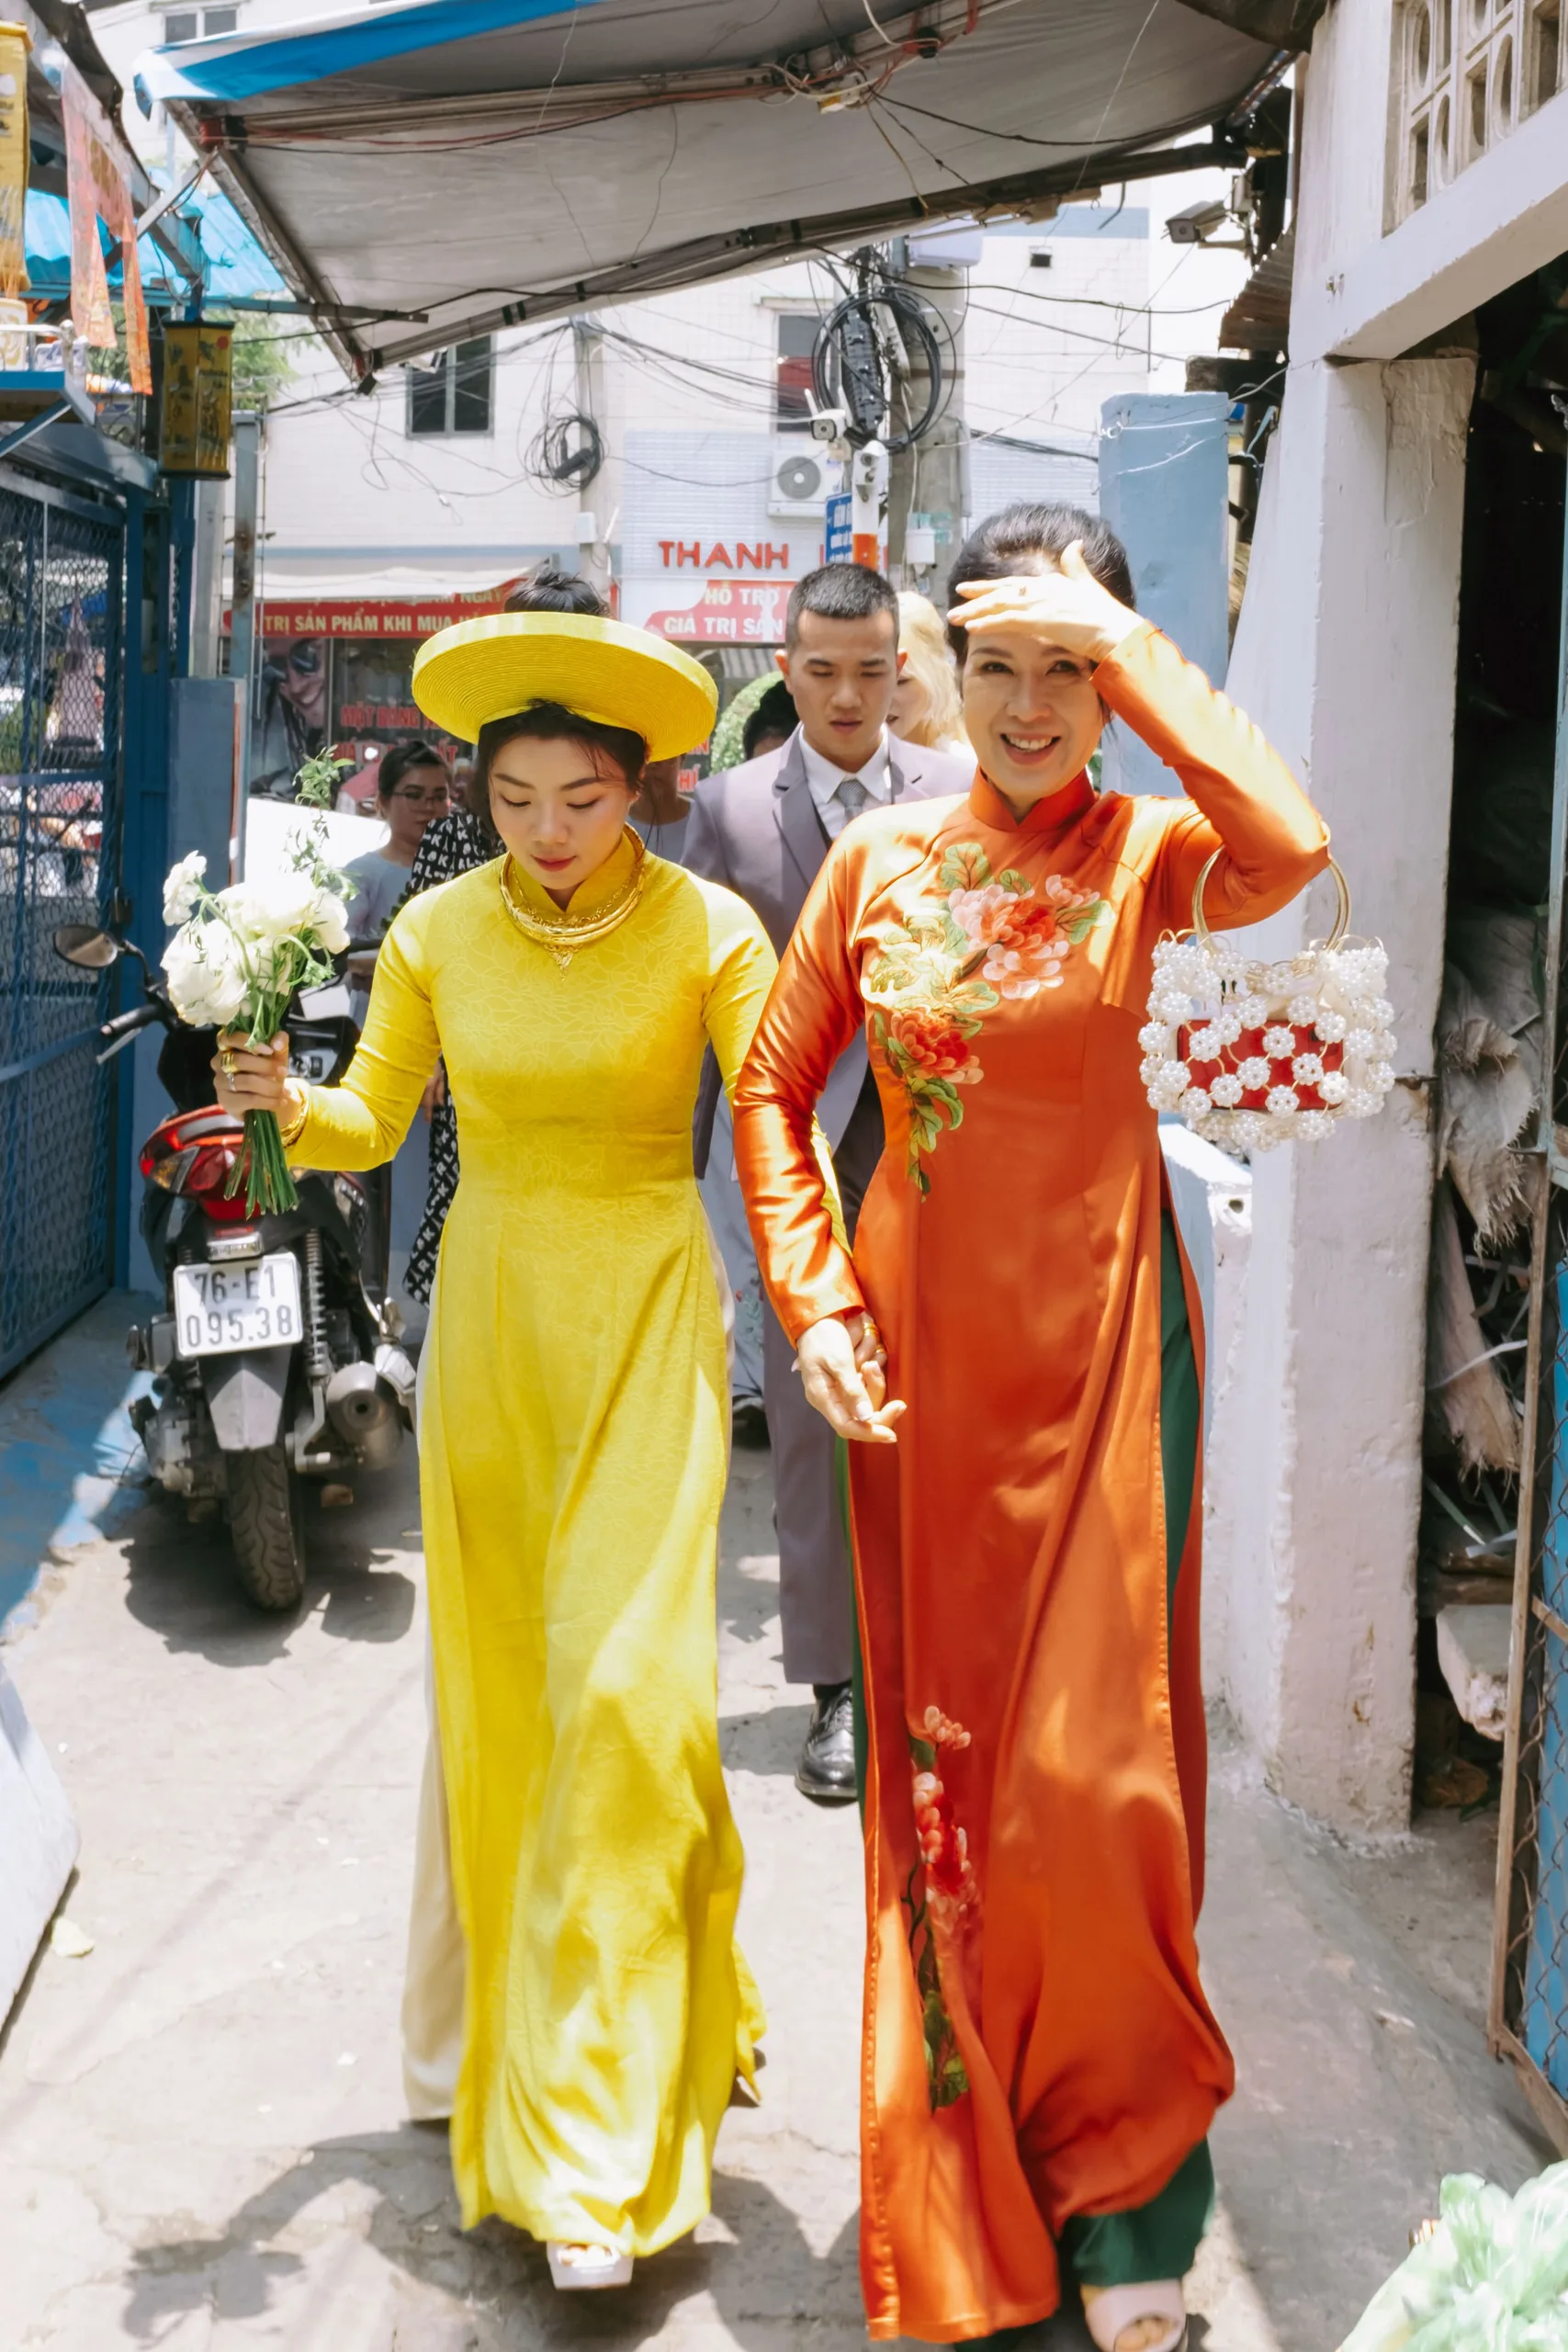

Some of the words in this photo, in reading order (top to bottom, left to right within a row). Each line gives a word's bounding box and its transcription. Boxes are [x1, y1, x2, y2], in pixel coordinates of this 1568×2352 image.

[658, 540, 789, 570] THANH
[264, 616, 290, 635] TRỊ
[294, 609, 327, 632] SẢN
[331, 606, 378, 632] PHẨM
[383, 616, 412, 632] KHI
[417, 616, 453, 632] MUA
[663, 612, 696, 635] GIÁ
[704, 616, 737, 639] TRỊ
[194, 1265, 276, 1306] 76-E1
[186, 1305, 293, 1348] 095.38
